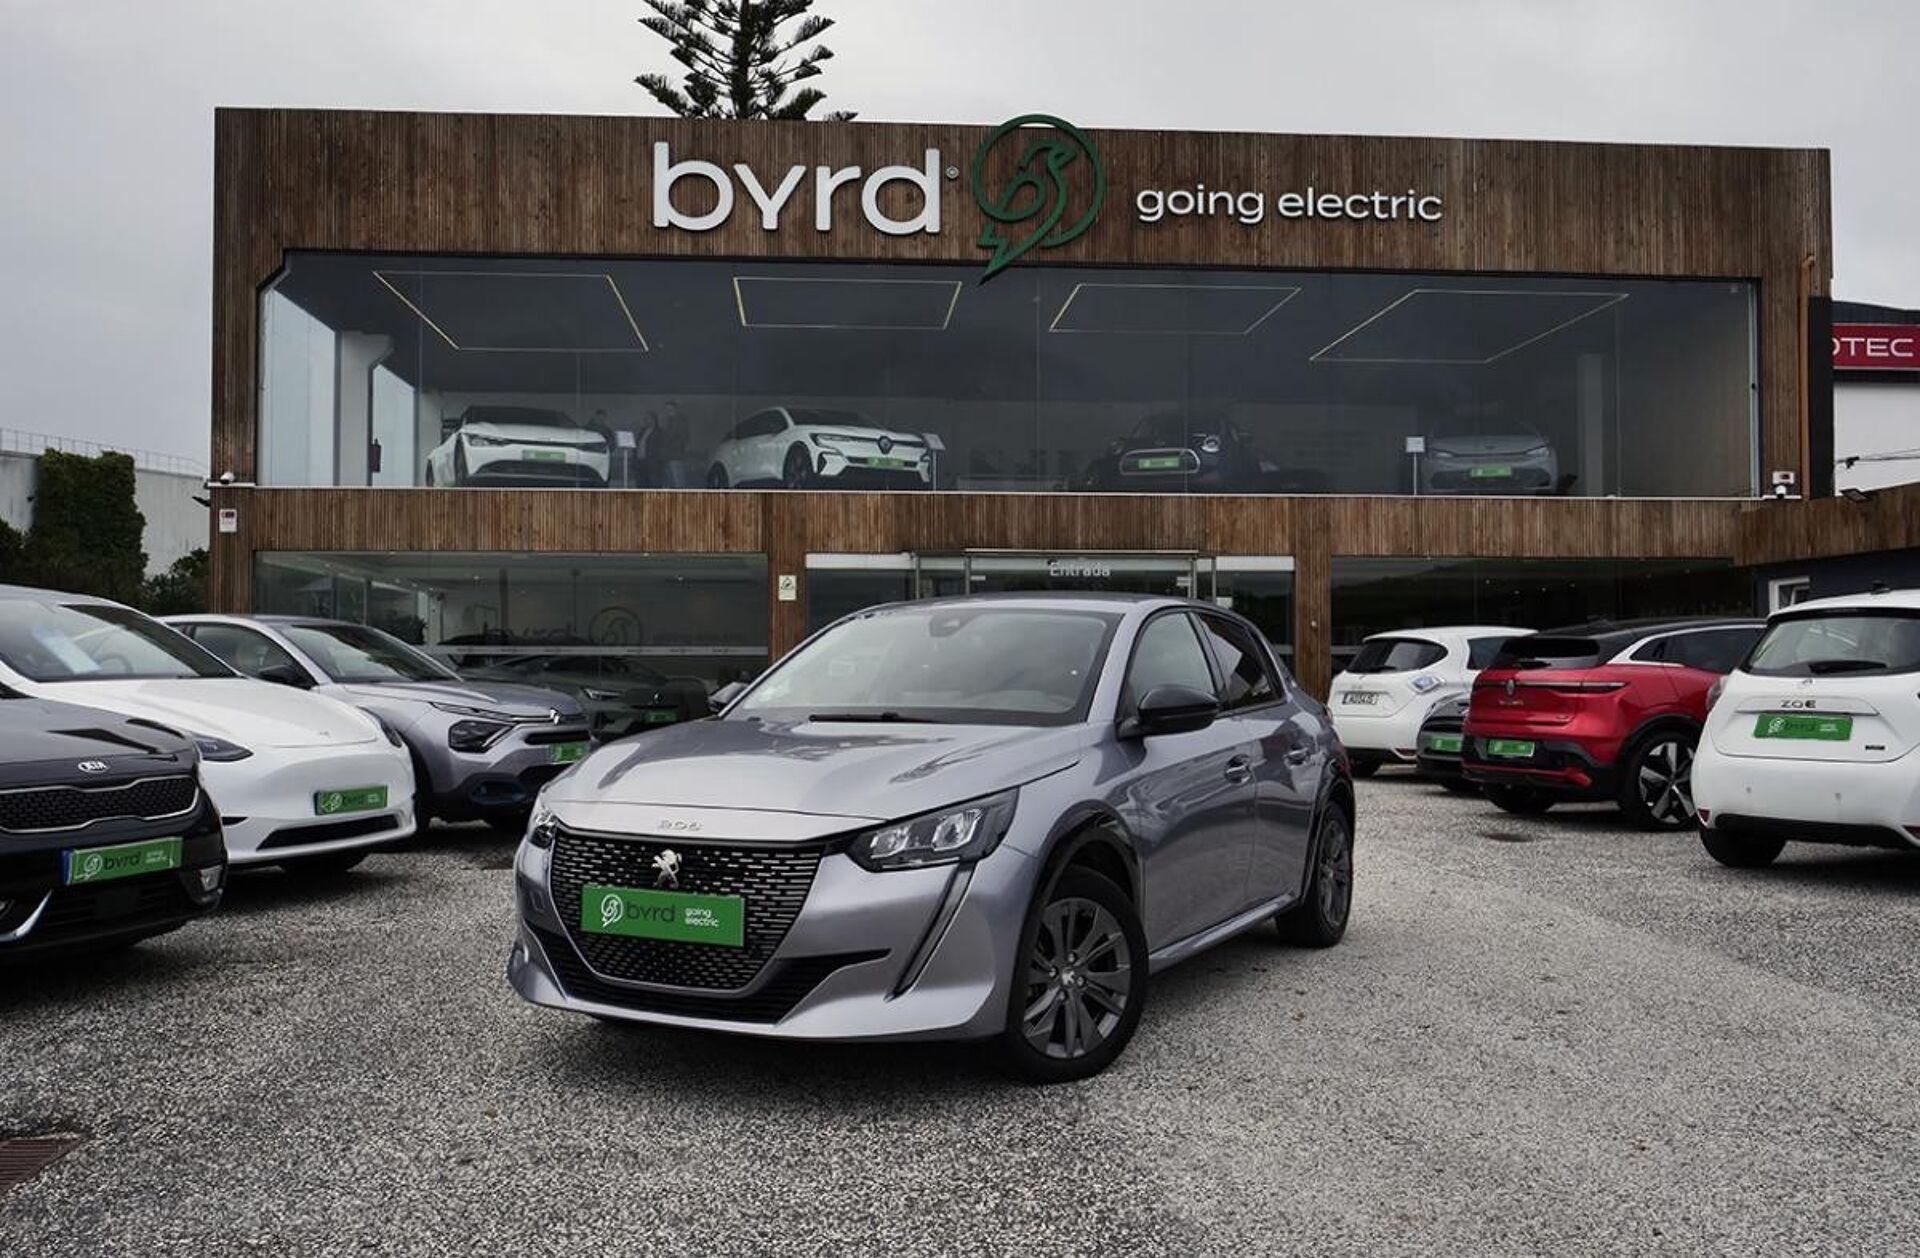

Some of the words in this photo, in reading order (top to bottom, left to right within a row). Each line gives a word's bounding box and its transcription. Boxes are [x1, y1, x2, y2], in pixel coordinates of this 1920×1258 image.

[653, 141, 941, 235] byrd
[1136, 184, 1265, 224] going
[1277, 187, 1443, 221] electric
[1050, 562, 1111, 577] Entrada
[627, 901, 676, 923] byrd
